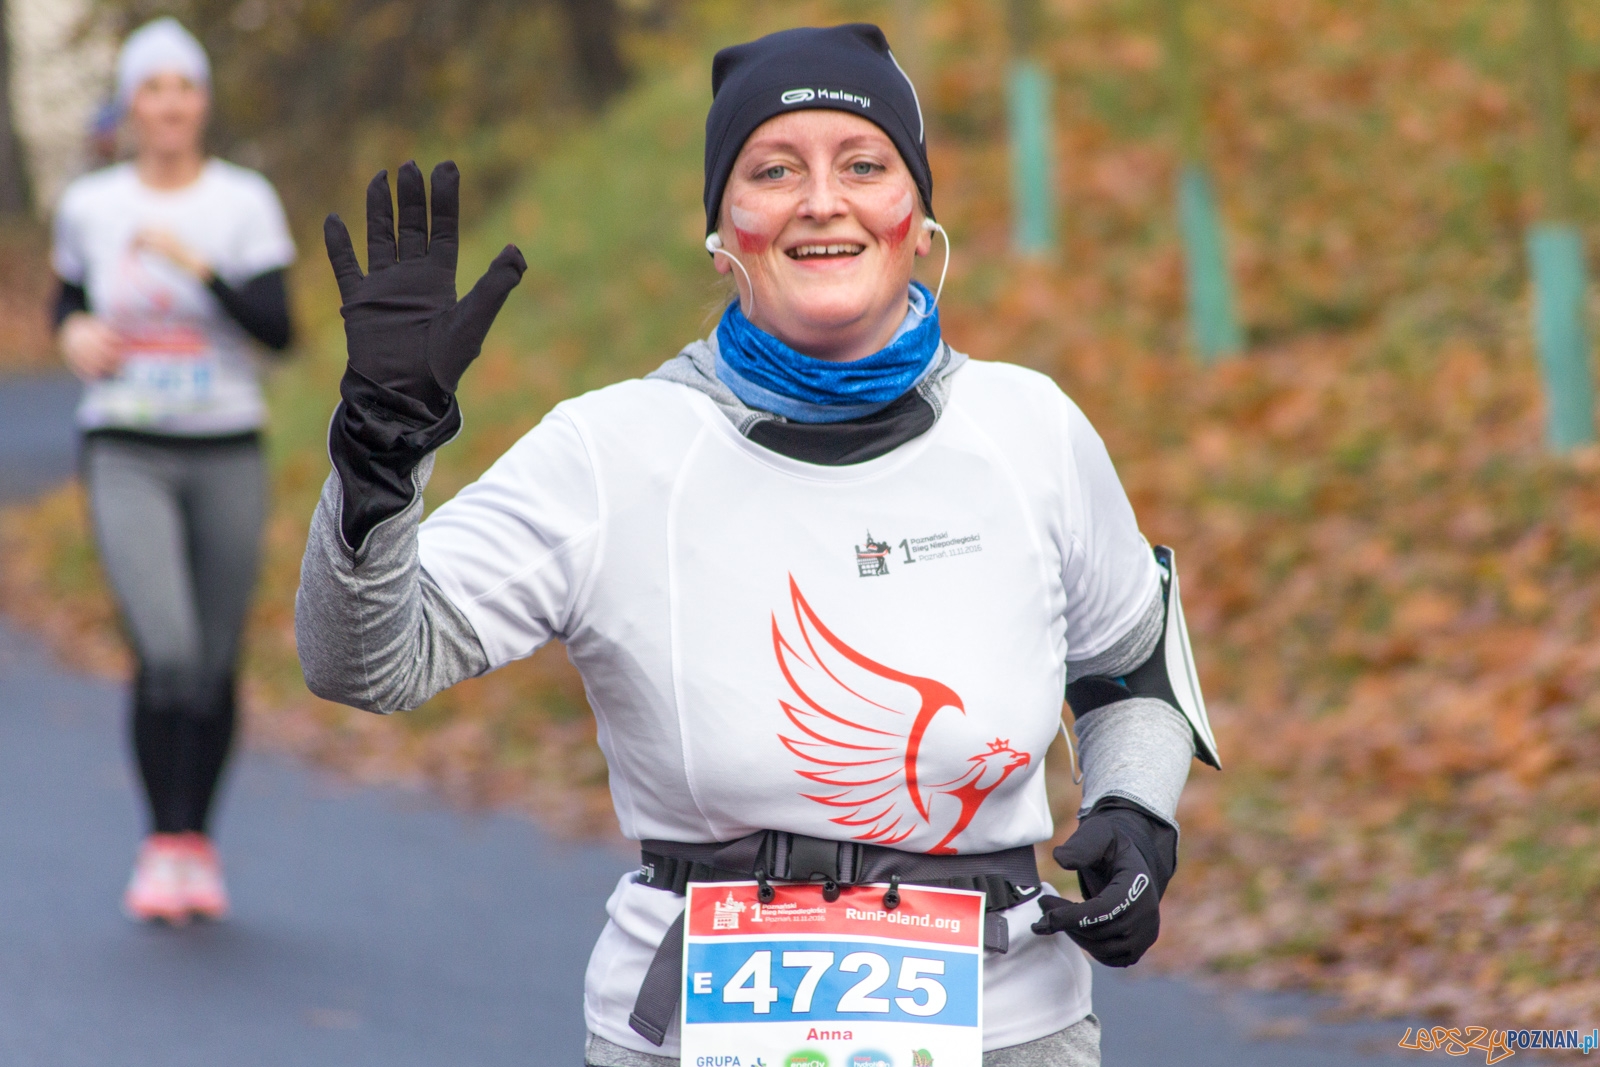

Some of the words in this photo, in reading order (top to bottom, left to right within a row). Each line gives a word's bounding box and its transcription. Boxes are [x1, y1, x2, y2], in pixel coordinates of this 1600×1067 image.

[818, 88, 870, 108] Kalenji
[910, 531, 948, 545] Poznański
[898, 539, 916, 564] 1
[912, 544, 929, 553] Bieg
[949, 544, 983, 557] 11.11.2016
[750, 902, 763, 922] 1
[845, 907, 961, 933] RunPoland.org
[693, 972, 713, 994] E
[722, 950, 948, 1017] 4725
[806, 1028, 853, 1041] Anna
[696, 1056, 741, 1067] GRUPA
